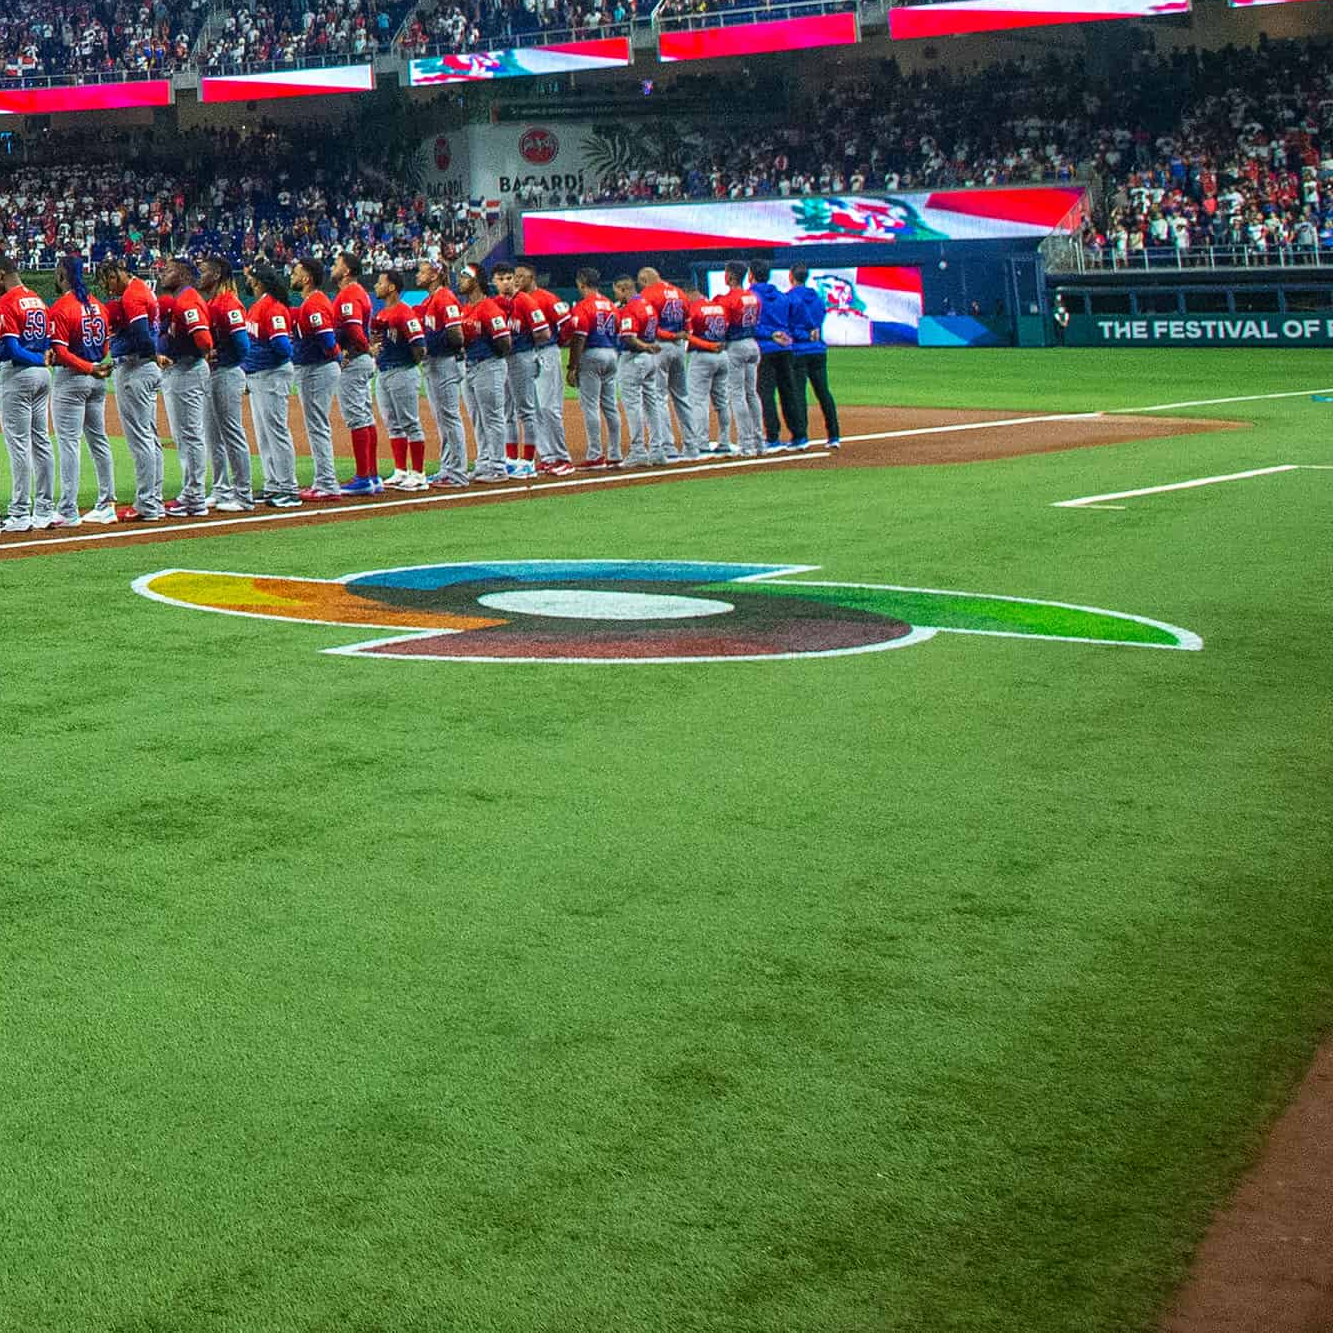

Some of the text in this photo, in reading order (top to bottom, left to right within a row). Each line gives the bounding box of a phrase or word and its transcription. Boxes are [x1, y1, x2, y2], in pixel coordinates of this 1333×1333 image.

[22, 310, 46, 341] 59
[81, 317, 105, 347] 53
[1097, 320, 1148, 339] THE
[1153, 320, 1278, 339] FESTIVAL
[1282, 319, 1320, 338] OF
